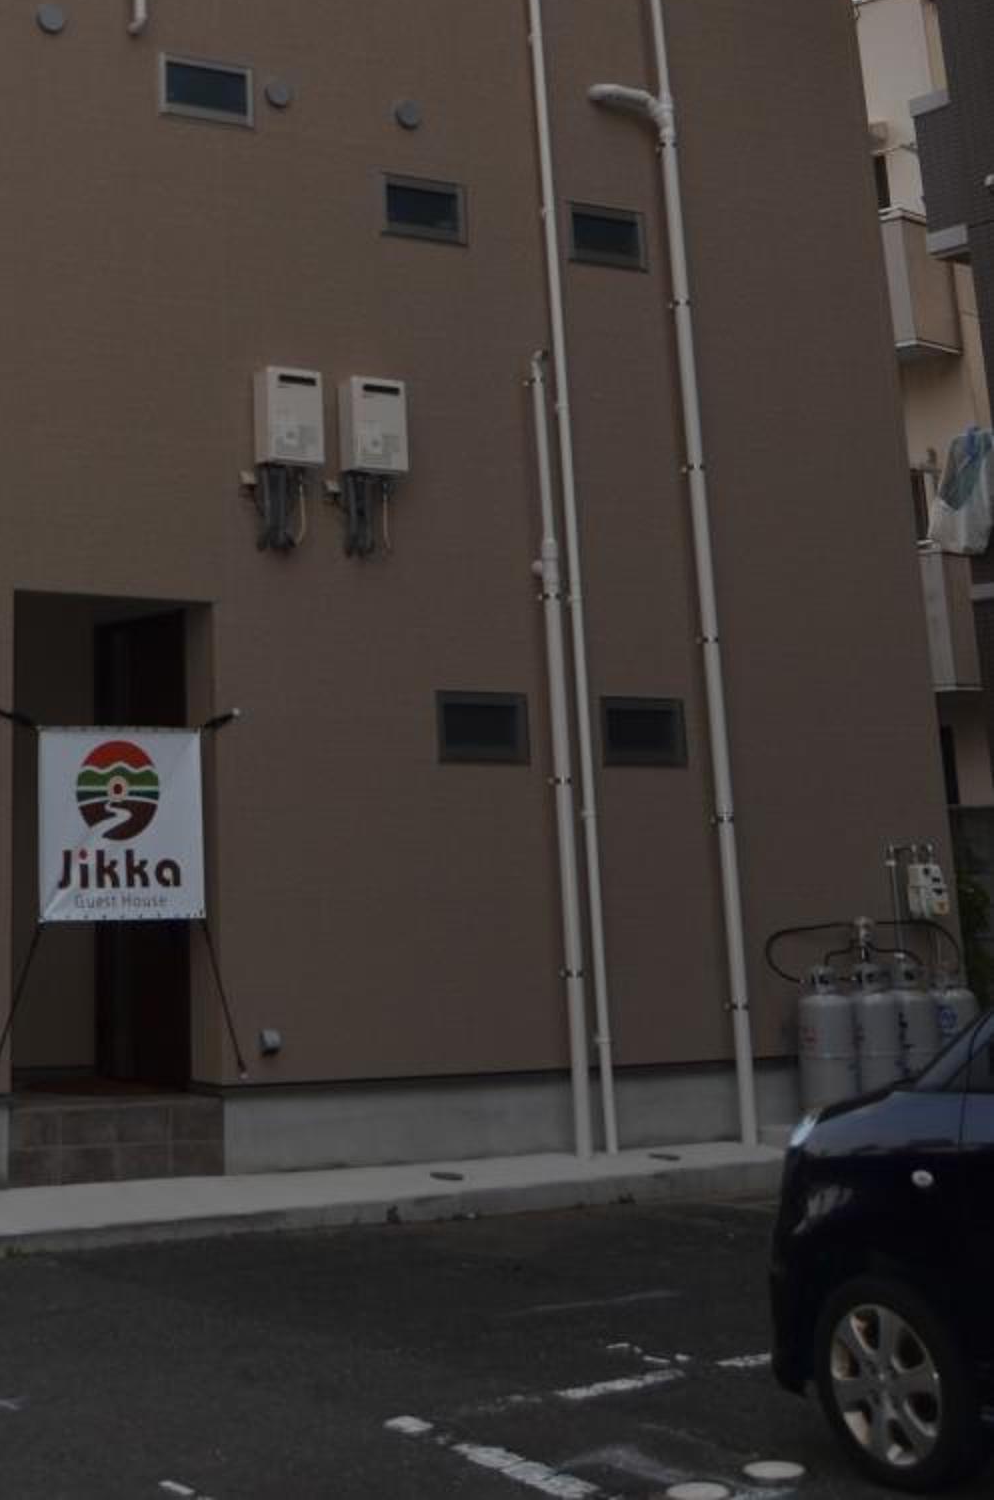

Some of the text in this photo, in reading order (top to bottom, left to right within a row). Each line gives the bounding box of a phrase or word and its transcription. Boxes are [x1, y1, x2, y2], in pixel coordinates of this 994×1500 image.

[58, 849, 182, 889] Jikka
[75, 894, 169, 909] Guest House
